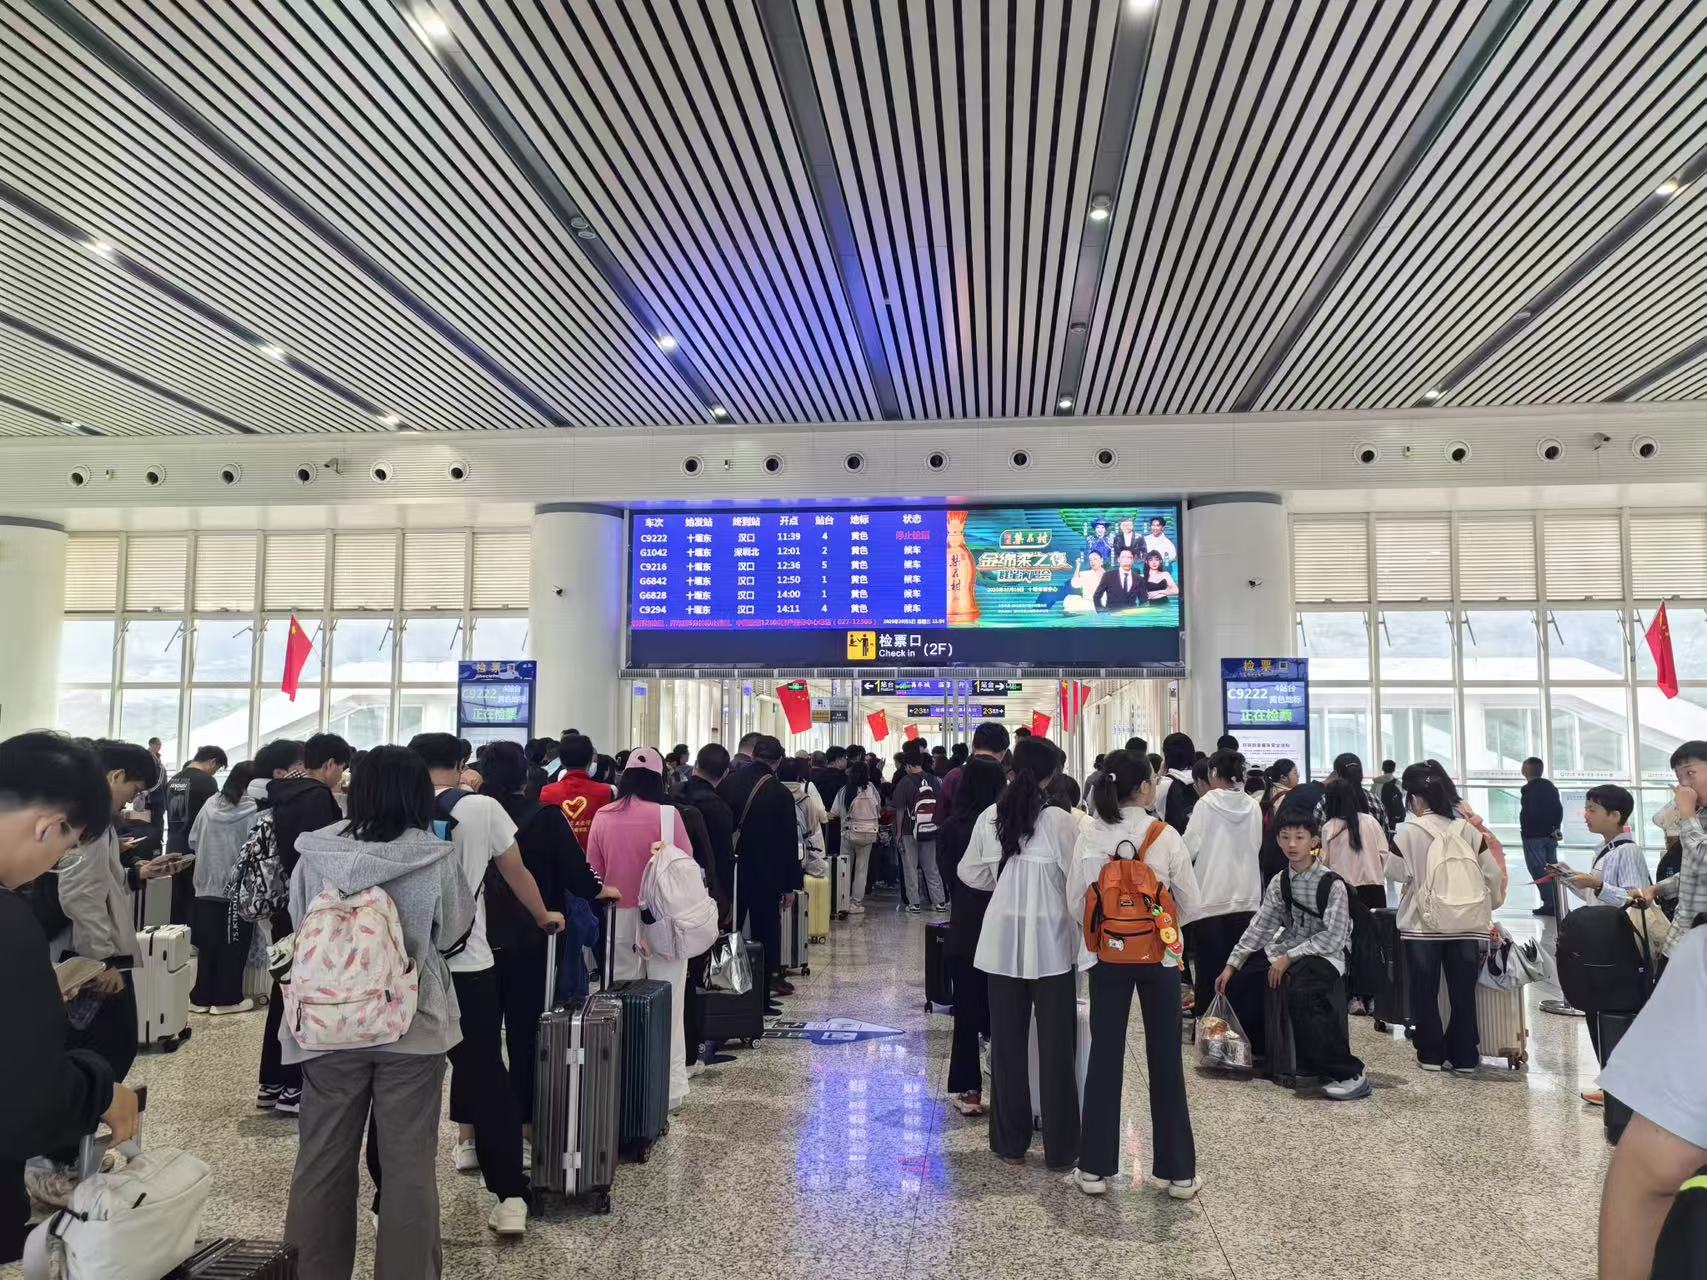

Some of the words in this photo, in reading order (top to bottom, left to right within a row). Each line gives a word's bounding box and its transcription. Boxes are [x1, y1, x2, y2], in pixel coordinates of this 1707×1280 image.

[645, 518, 664, 528] 车次
[685, 517, 713, 527] 始发站
[732, 516, 760, 527] 终到站
[780, 516, 798, 526] 开点
[815, 515, 834, 525] 站台
[850, 515, 869, 525] 地标
[902, 514, 922, 524] 状态
[640, 534, 668, 543] C9222
[687, 533, 712, 543] 十堰东
[738, 533, 755, 542] 汉口
[777, 533, 801, 541] 11:39
[821, 532, 828, 540] 4
[851, 532, 869, 541] 黄色
[640, 548, 668, 557] G1042
[687, 547, 712, 557] 十堰东
[777, 547, 801, 555] 12:01
[821, 546, 828, 554] 2
[851, 546, 869, 555] 黄色
[904, 545, 921, 555] 候车
[640, 563, 667, 571] C9216
[686, 562, 711, 572] 十堰东
[738, 562, 755, 571] 汉口
[777, 561, 801, 569] 12:36
[821, 560, 828, 568] 5
[851, 561, 869, 570] 黄色
[904, 560, 921, 570] 候车
[639, 577, 667, 585] G6842
[686, 576, 710, 586] 十堰东
[737, 576, 755, 586] 汉口
[777, 576, 801, 584] 12:50
[821, 575, 828, 583] 1
[851, 575, 869, 584] 黄色
[904, 575, 921, 584] 候车
[639, 591, 667, 600] G6828
[686, 591, 710, 600] 十堰东
[737, 590, 754, 600] 汉口
[777, 590, 801, 598] 14:00
[821, 589, 828, 597] 1
[851, 590, 869, 599] 黄色
[904, 589, 921, 599] 候车
[639, 606, 667, 614] C9294
[686, 605, 710, 615] 十堰东
[737, 605, 754, 614] 汉口
[777, 604, 801, 612] 14:11
[821, 603, 828, 611] 4
[851, 604, 869, 613] 黄色
[904, 604, 921, 613] 候车
[879, 634, 921, 648] 检票口
[879, 649, 906, 657] Check
[907, 649, 915, 657] in
[923, 642, 953, 656] (2F)
[1243, 660, 1289, 671] 检票口
[462, 688, 497, 699] C9222
[1228, 688, 1268, 699] C9222
[1275, 684, 1296, 692] 4站台
[1269, 695, 1302, 704] 黄色地标
[472, 708, 518, 720] 正在检票
[1240, 709, 1293, 722] 正在检票
